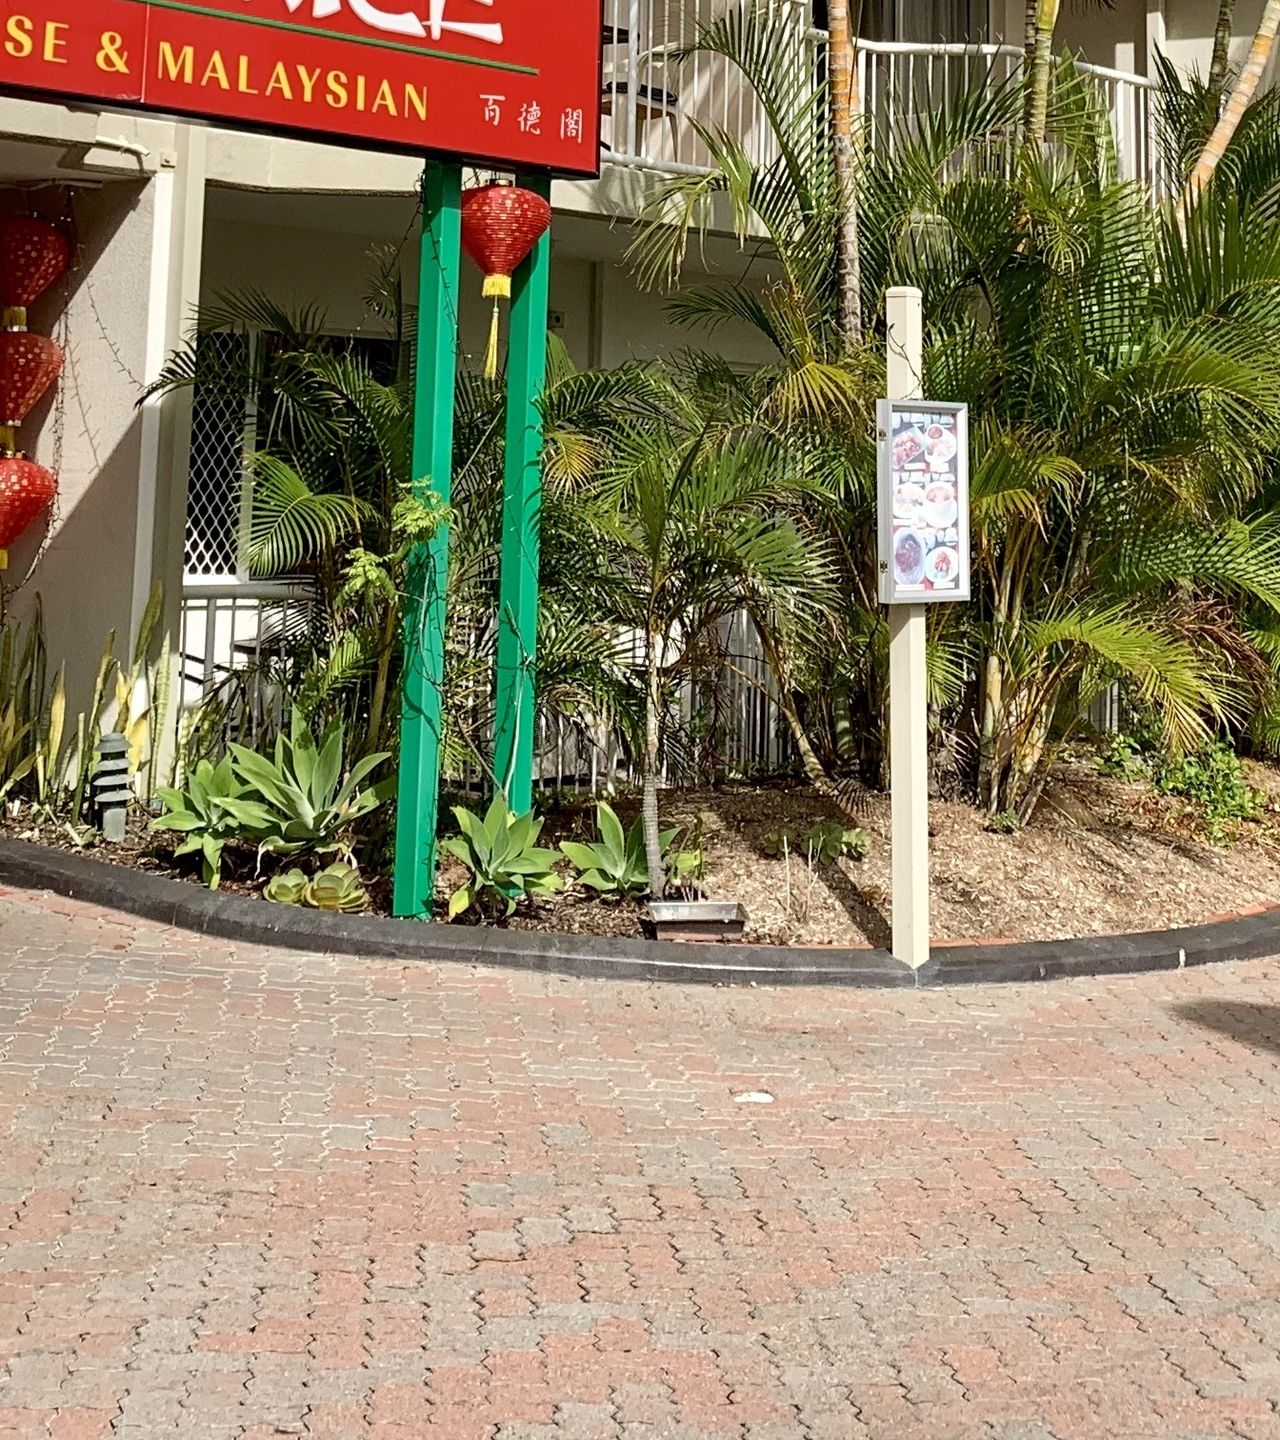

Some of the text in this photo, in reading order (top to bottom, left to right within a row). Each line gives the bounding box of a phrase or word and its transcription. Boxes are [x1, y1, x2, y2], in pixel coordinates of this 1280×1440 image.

[95, 30, 131, 75] &
[157, 41, 429, 122] MALAYSIAN
[479, 93, 584, 145] 百德閣
